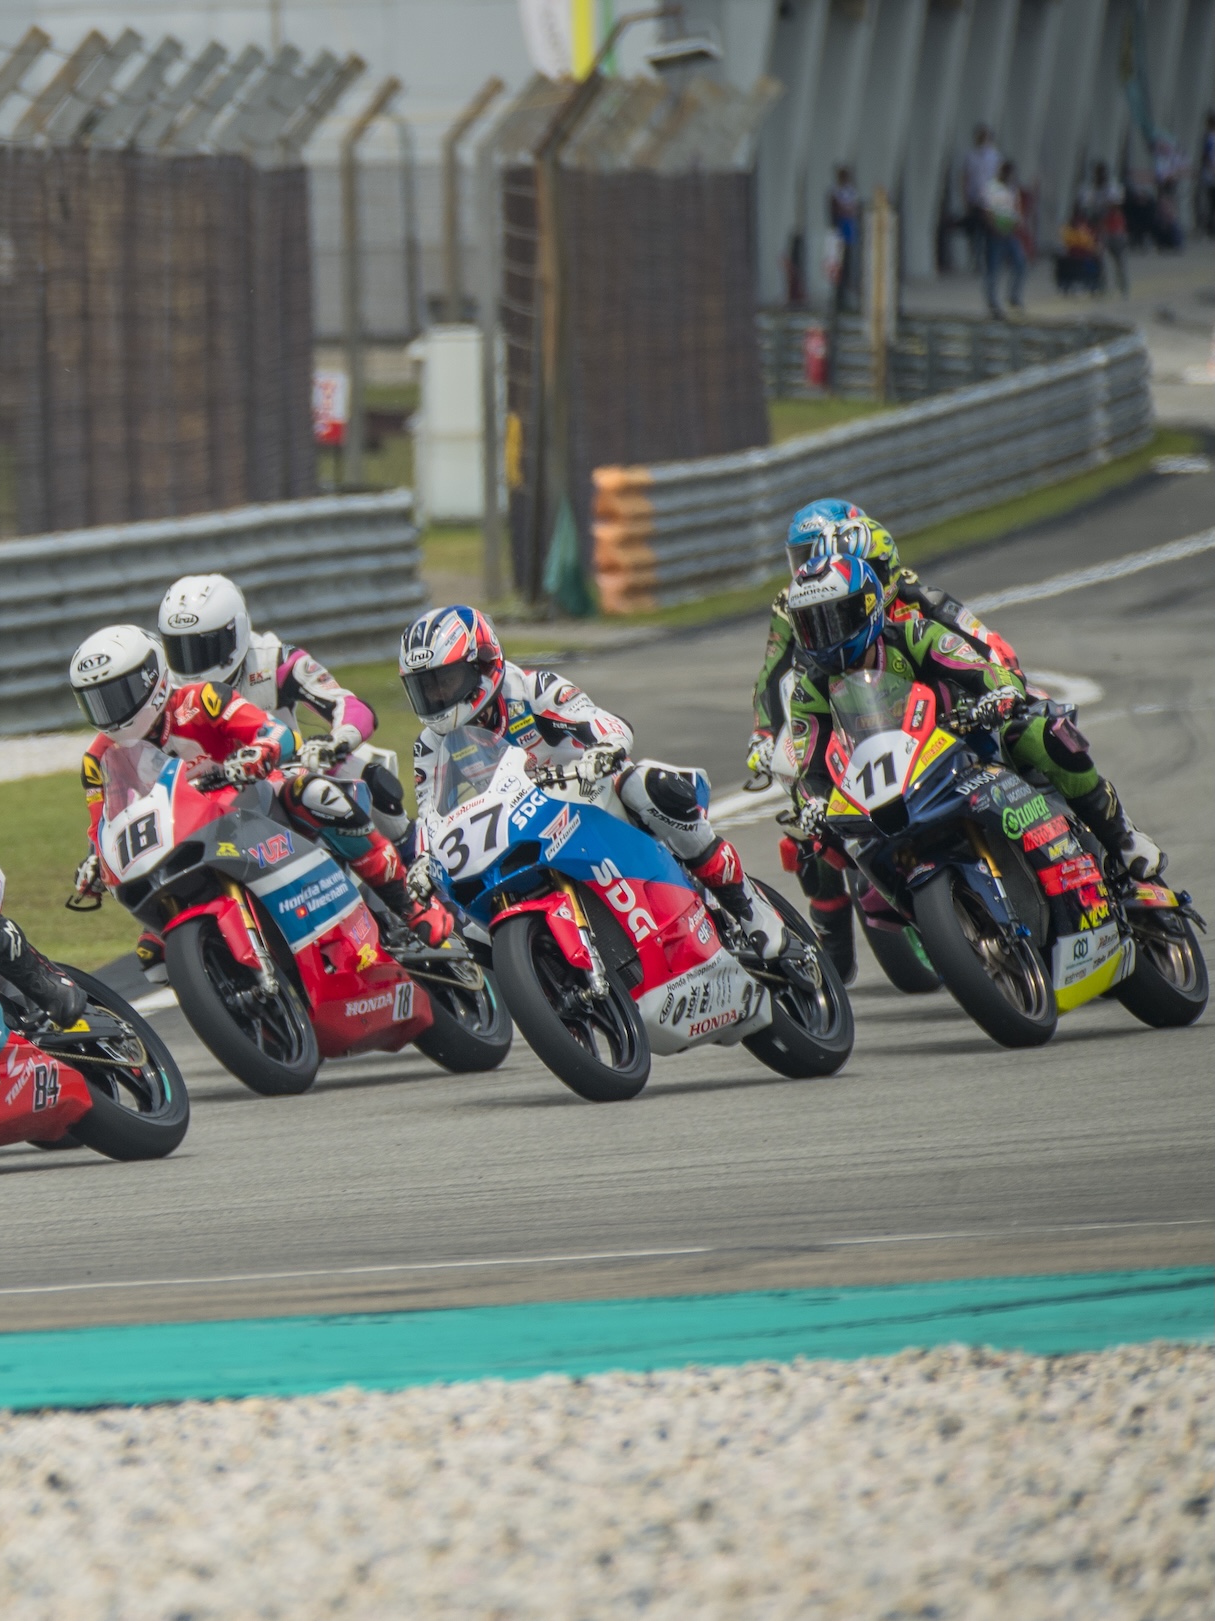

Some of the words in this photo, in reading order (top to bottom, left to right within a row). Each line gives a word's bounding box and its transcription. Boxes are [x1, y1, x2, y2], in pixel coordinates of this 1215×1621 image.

[172, 613, 196, 626] Arai
[82, 656, 103, 669] KYT
[407, 649, 430, 665] Arai
[856, 751, 897, 800] 11
[955, 771, 997, 795] DENSO
[588, 785, 606, 804] HONDA
[512, 791, 548, 831] SDG
[1015, 794, 1050, 829] CLOVER
[116, 811, 160, 870] 18
[248, 830, 294, 868] YUZY
[438, 802, 503, 877] 37
[278, 883, 320, 914] Honda
[306, 882, 349, 913] Vietnam
[590, 858, 659, 943] SDG
[396, 983, 412, 1019] 18
[666, 978, 687, 993] Honda
[345, 992, 394, 1017] HONDA
[688, 1008, 738, 1037] HONDA
[33, 1060, 61, 1112] 84
